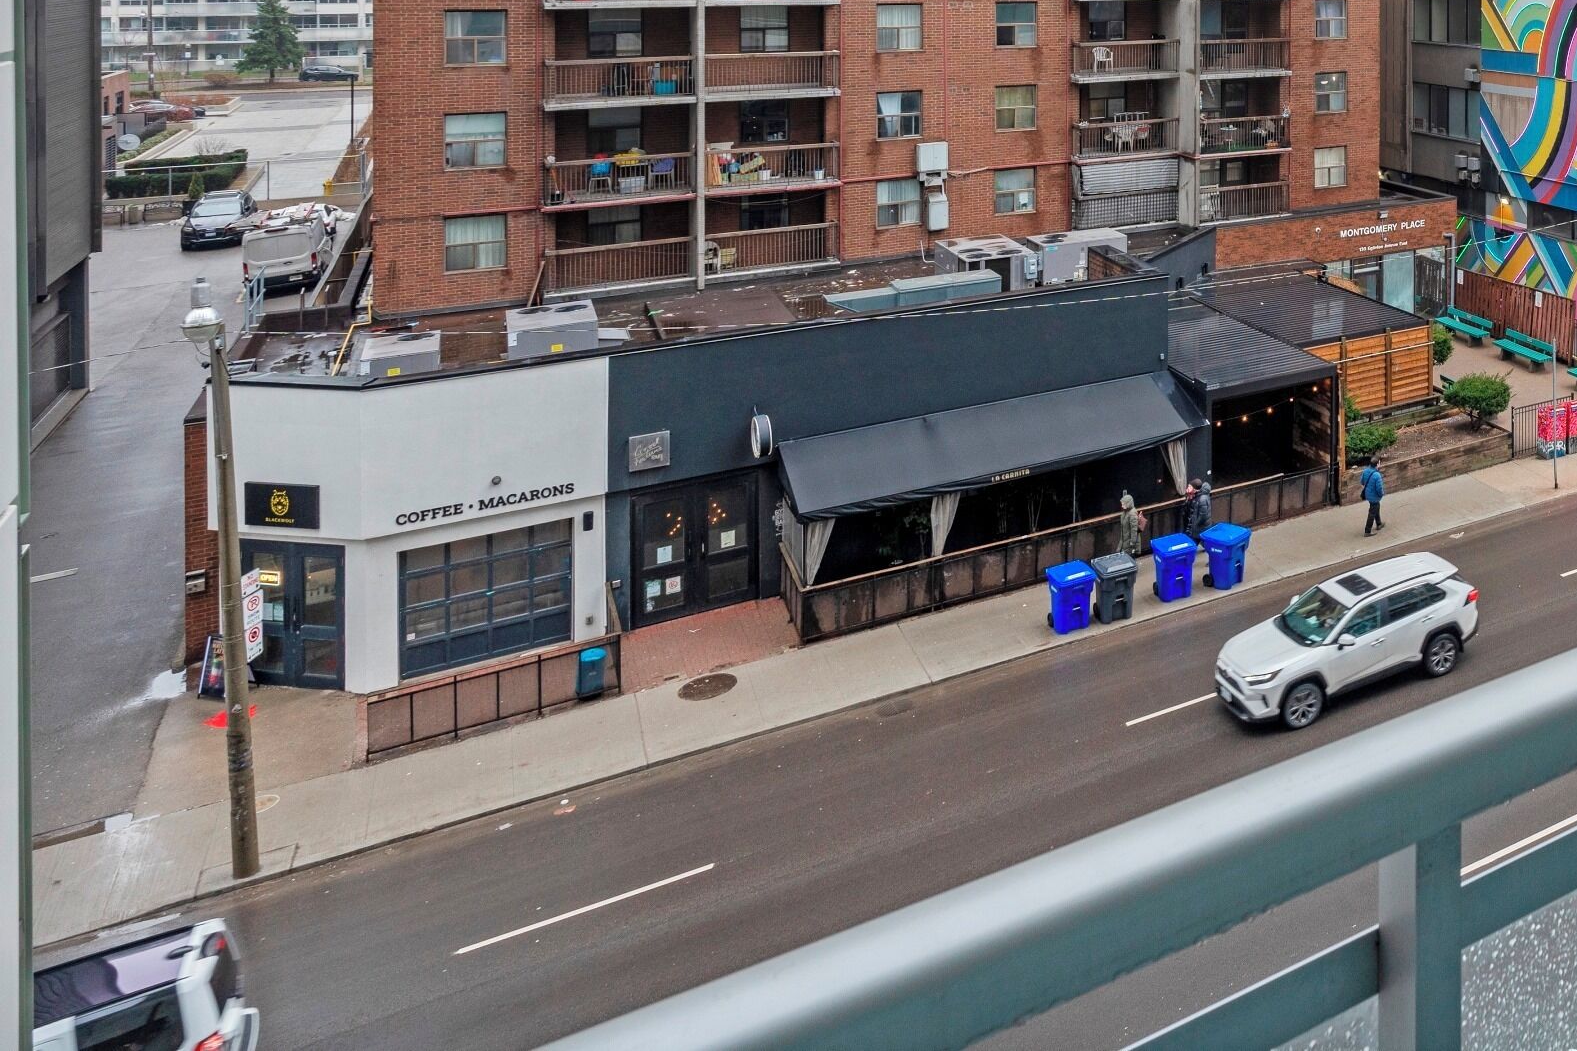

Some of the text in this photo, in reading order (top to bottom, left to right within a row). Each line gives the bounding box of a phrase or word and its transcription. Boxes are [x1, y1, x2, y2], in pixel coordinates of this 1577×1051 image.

[1340, 219, 1426, 238] MONTGOMERY PLACE
[1001, 468, 1030, 481] CARNITA
[395, 482, 575, 526] COFFEE MACARONS
[260, 573, 279, 583] OPEN
